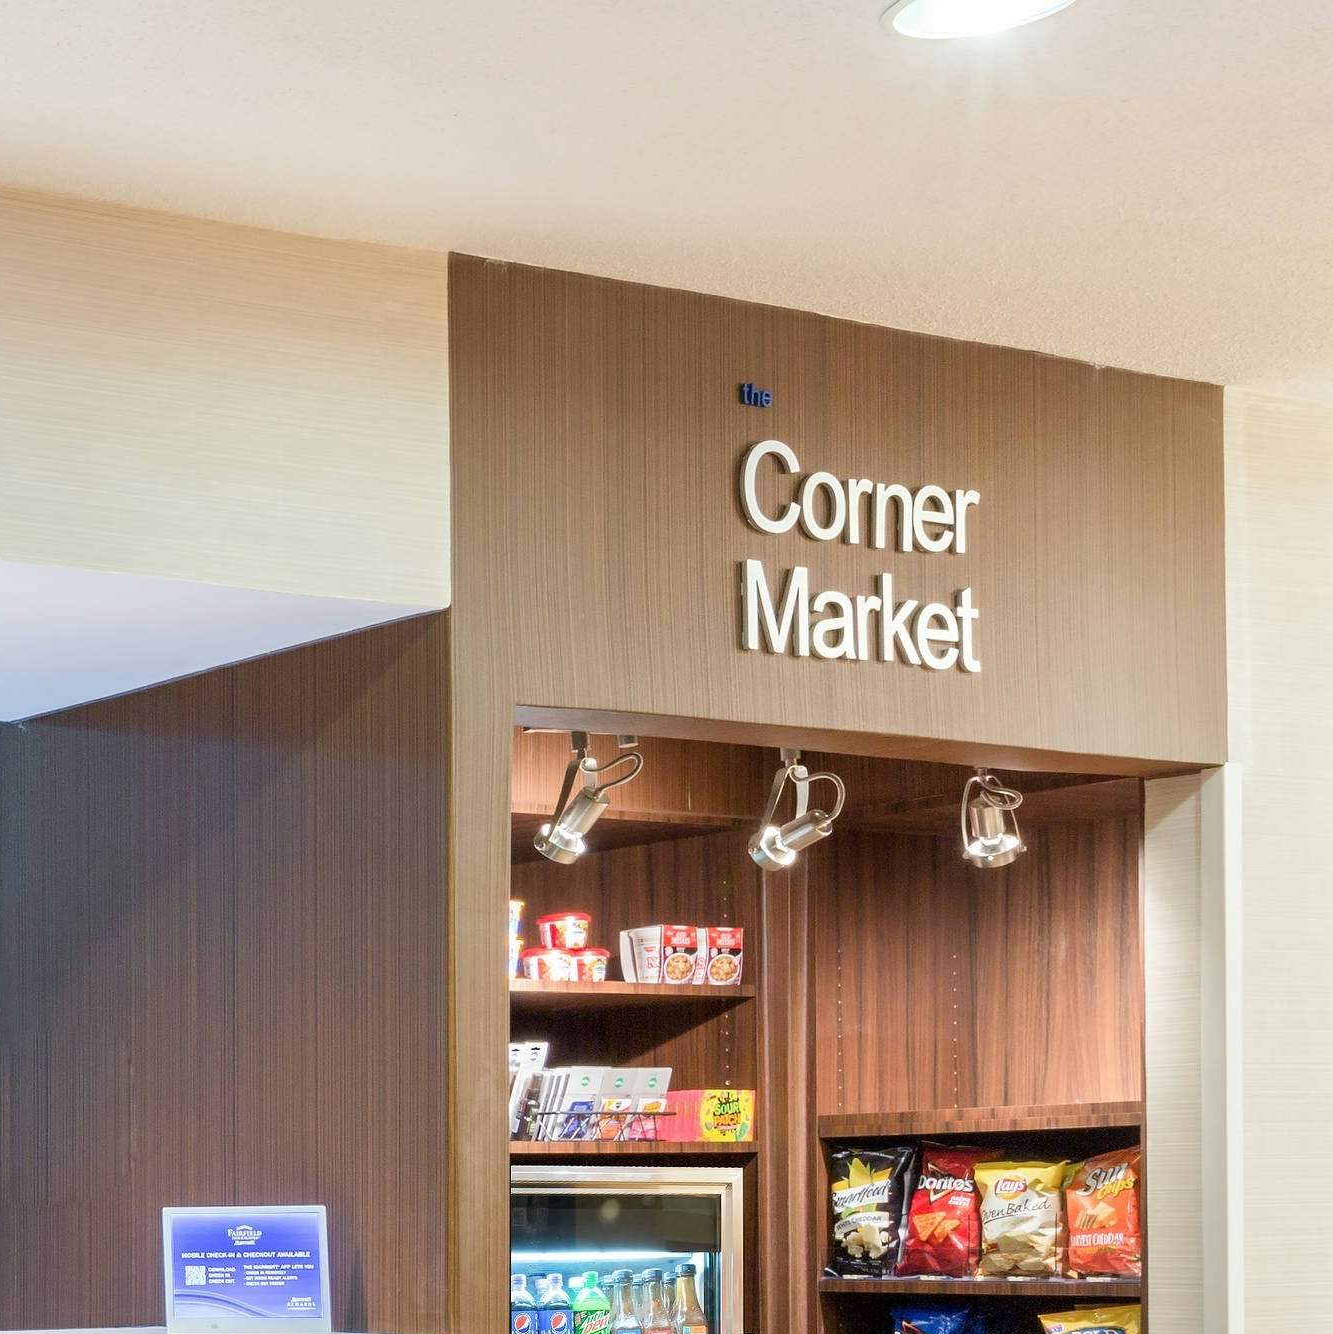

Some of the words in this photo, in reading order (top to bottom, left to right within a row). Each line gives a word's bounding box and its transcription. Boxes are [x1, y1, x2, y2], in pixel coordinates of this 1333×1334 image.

[741, 382, 773, 408] the
[740, 439, 981, 554] Corner
[741, 558, 981, 673] Market
[714, 1101, 741, 1116] SOUR
[917, 1174, 974, 1192] Doritos
[1006, 1200, 1051, 1214] Baked
